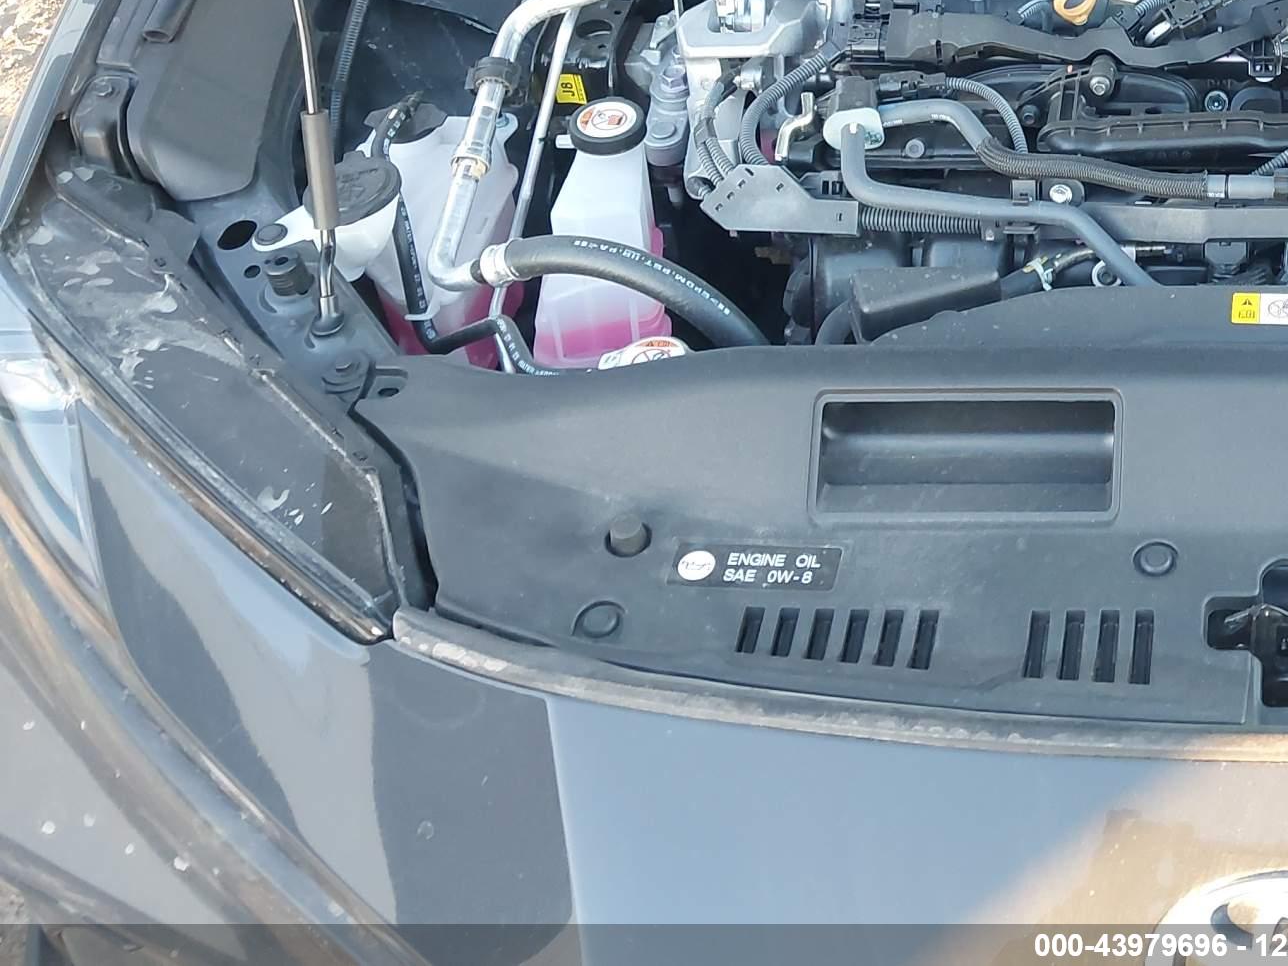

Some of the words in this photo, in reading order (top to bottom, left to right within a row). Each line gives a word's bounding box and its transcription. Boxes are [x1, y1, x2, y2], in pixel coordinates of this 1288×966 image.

[727, 552, 786, 567] ENGINE
[795, 554, 821, 569] OIL
[723, 569, 756, 582] SAE
[767, 570, 813, 584] 0W-8
